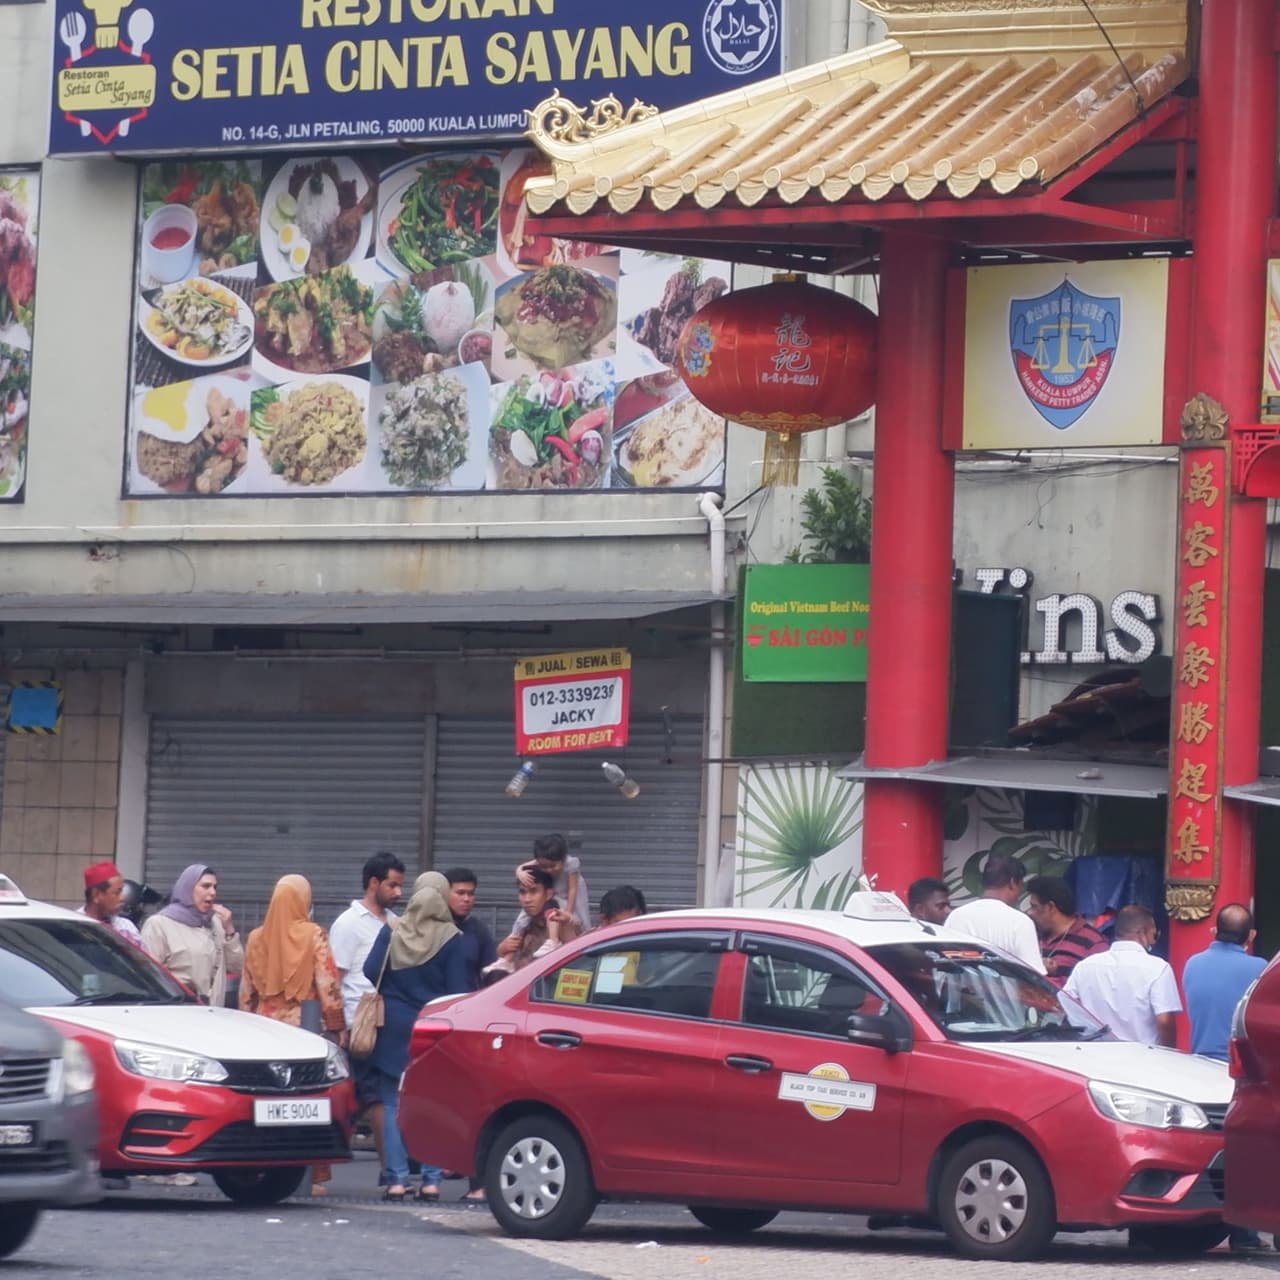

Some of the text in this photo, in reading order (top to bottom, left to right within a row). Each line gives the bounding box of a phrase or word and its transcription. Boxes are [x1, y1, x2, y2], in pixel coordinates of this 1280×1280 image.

[170, 21, 693, 102] SETIA CINTA SAYANG
[64, 69, 110, 81] Restoran
[65, 81, 92, 98] Setia
[110, 88, 152, 106] Sayang
[222, 114, 528, 142] NO. 14-G, JLN PETALING, 50000 KUALA LUMPU
[790, 601, 828, 613] Vietnam
[538, 660, 567, 673] JUAL
[576, 656, 608, 669] SEWA
[552, 708, 596, 725] JACKY
[528, 735, 561, 751] ROOM
[564, 733, 586, 747] FOR
[267, 1104, 319, 1119] HWE 9004
